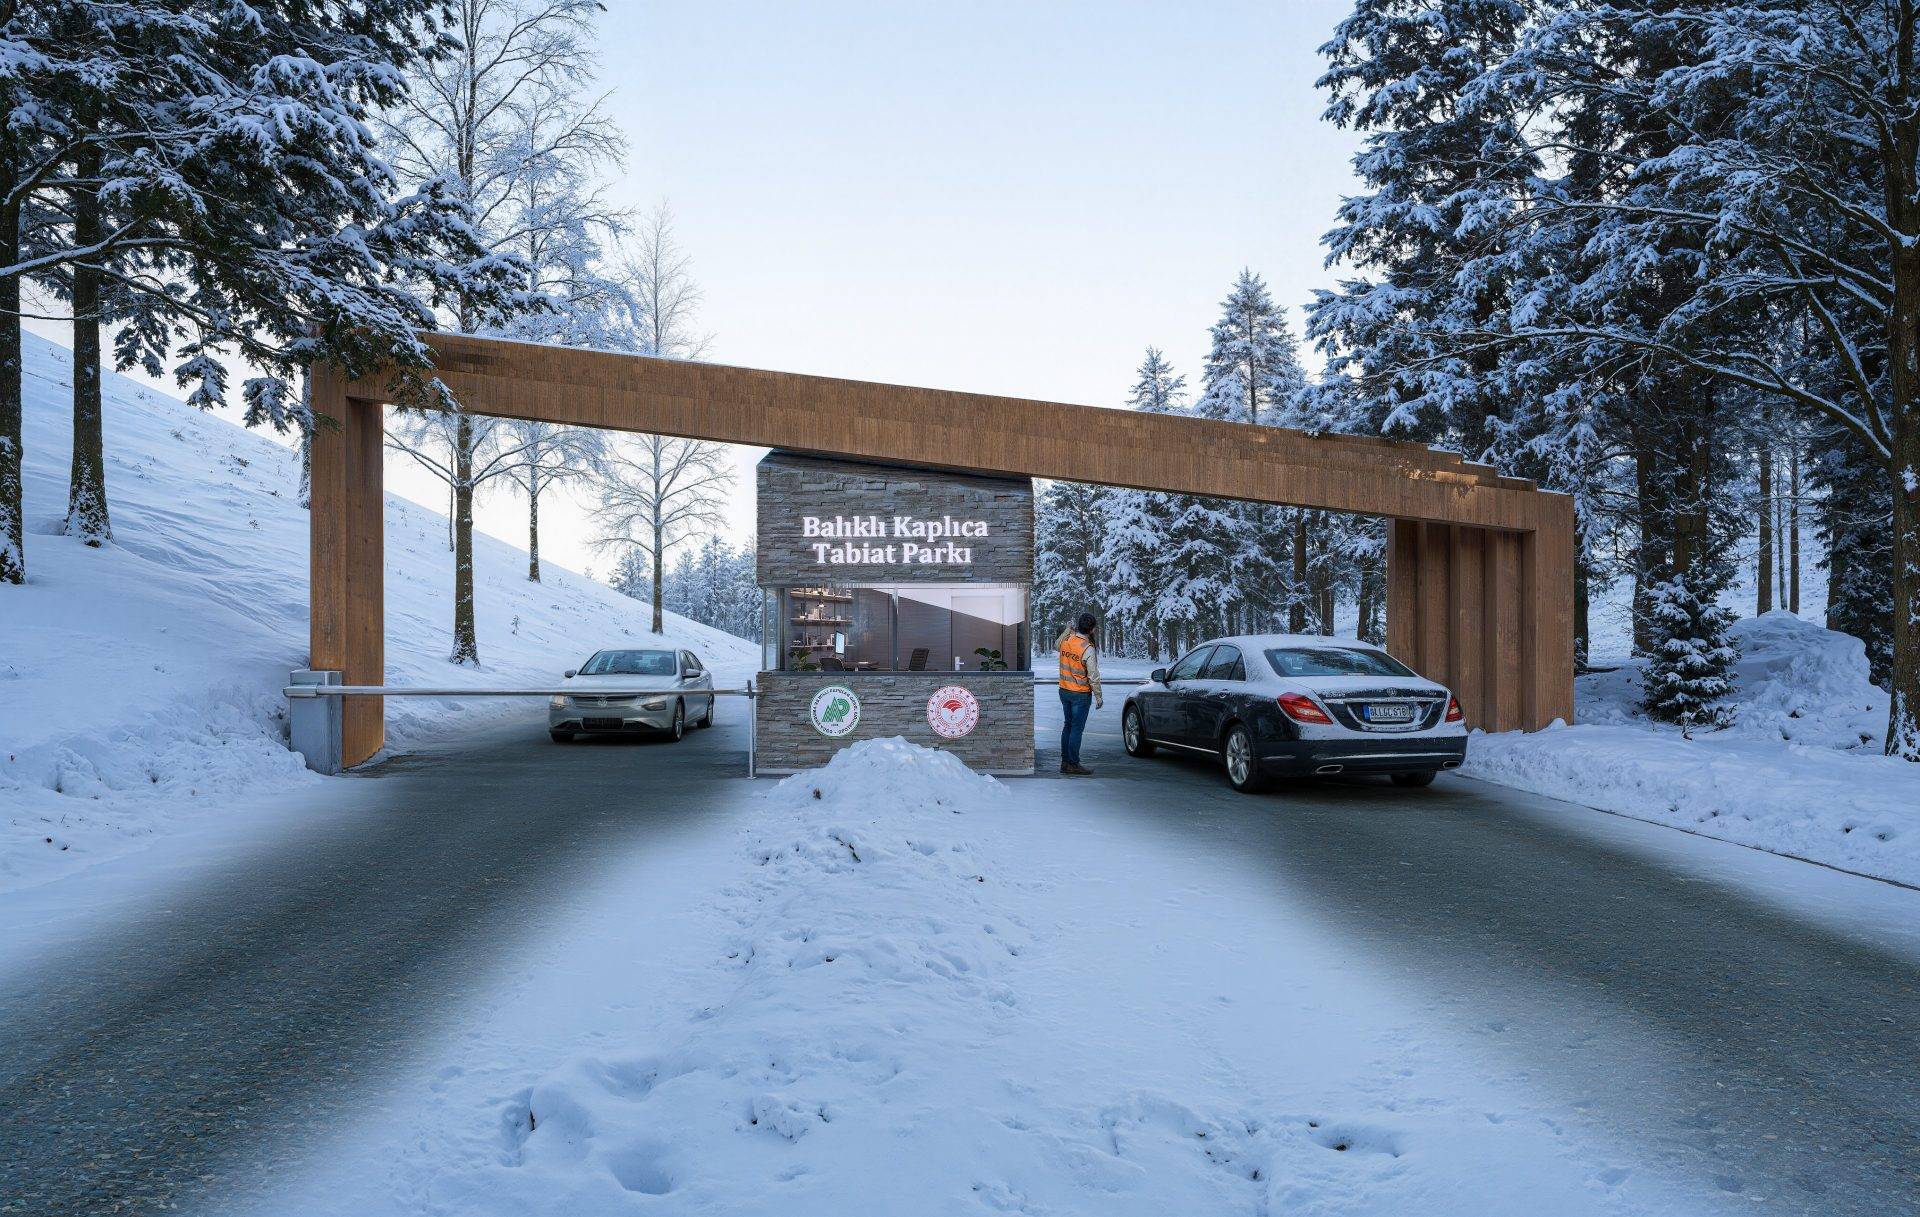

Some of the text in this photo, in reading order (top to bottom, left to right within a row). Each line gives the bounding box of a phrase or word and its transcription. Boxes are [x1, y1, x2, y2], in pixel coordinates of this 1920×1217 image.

[802, 515, 989, 543] Balıklı Kaplıca
[812, 542, 972, 564] Tabiat Parkı
